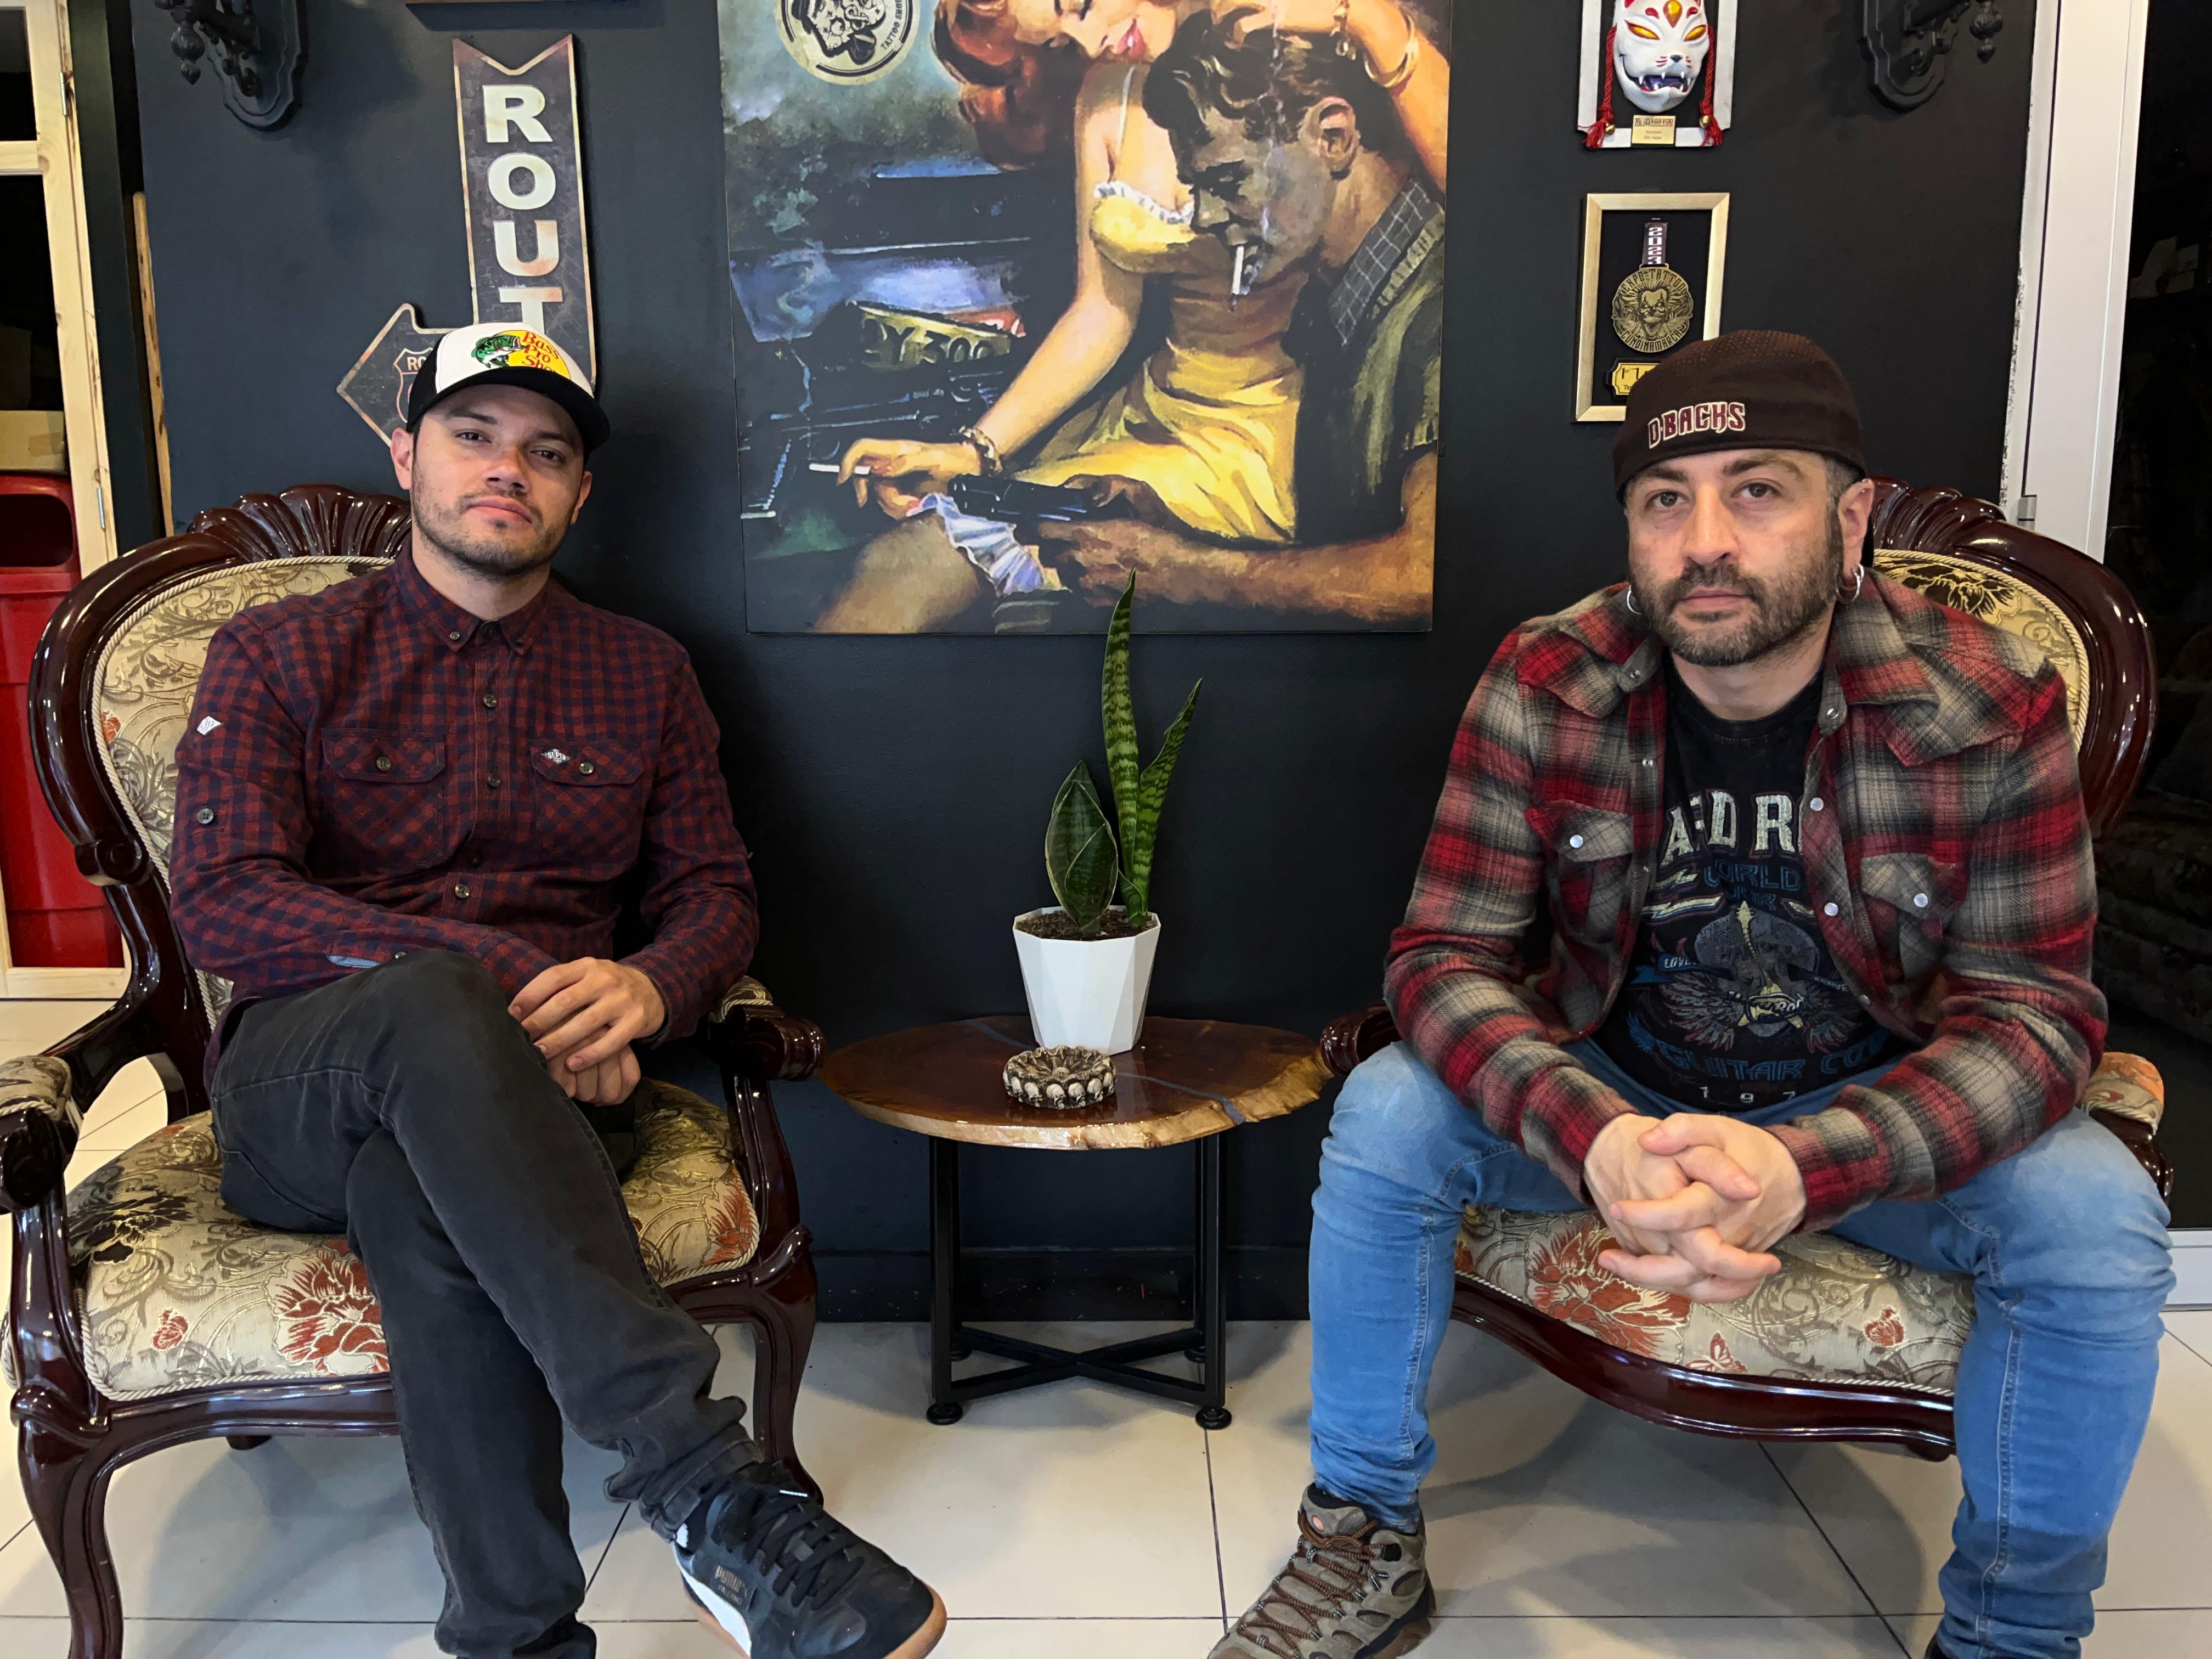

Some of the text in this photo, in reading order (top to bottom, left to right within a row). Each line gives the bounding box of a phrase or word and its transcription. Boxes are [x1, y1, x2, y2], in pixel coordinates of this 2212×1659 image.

[880, 21, 900, 50] TATTOO
[482, 84, 563, 334] ROUT
[1648, 227, 1662, 264] 2023
[1621, 268, 1686, 292] EXPO TATTOO
[522, 331, 559, 359] Bass
[524, 344, 551, 363] Pro
[1621, 330, 1683, 352] CUNDINAMARCA
[407, 356, 427, 371] RO
[1658, 1041, 1806, 1081] GUITAR
